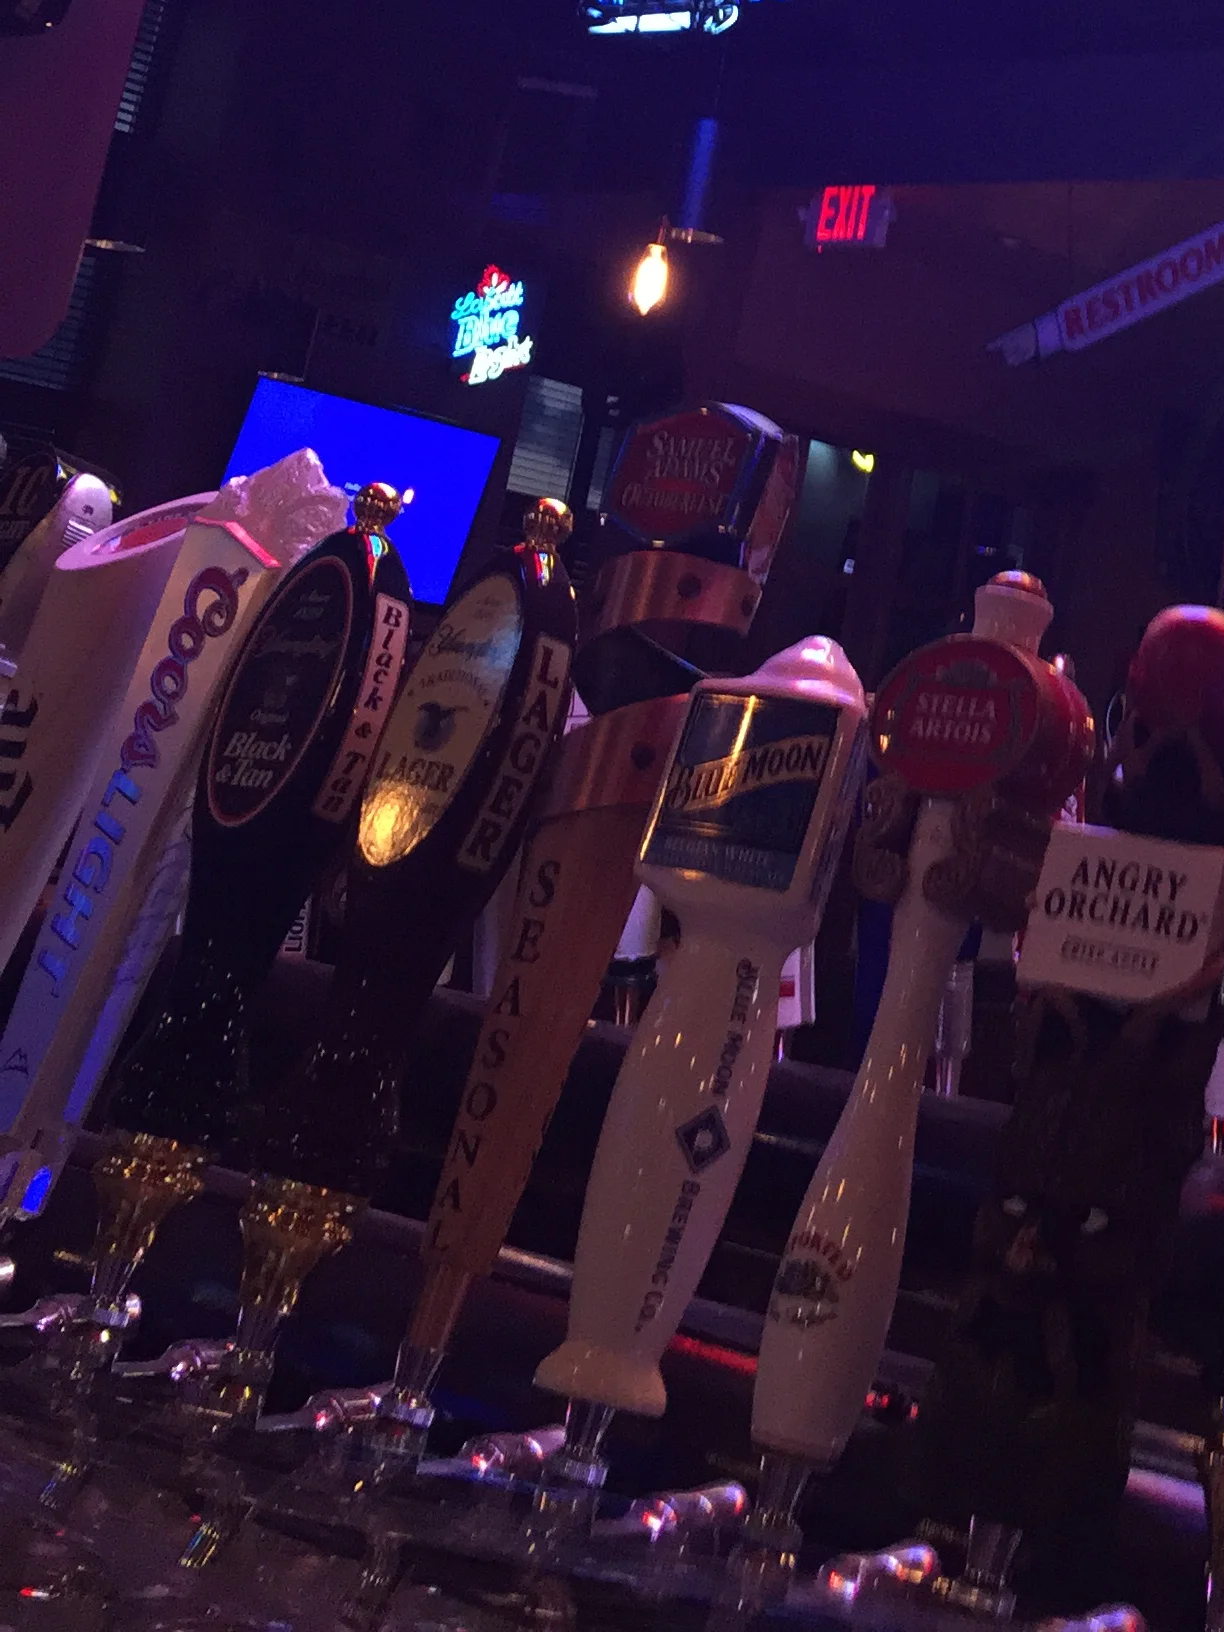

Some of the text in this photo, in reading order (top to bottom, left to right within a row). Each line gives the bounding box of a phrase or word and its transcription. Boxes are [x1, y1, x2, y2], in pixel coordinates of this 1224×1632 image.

[816, 184, 877, 242] EXIT
[908, 716, 993, 745] ARTOIS
[915, 691, 999, 724] STELLA
[465, 644, 560, 863] LAGER
[742, 741, 823, 784] MOON
[1071, 856, 1188, 903] ANGRY
[1043, 888, 1199, 944] ORCHARD
[428, 858, 561, 1253] SEASONAL
